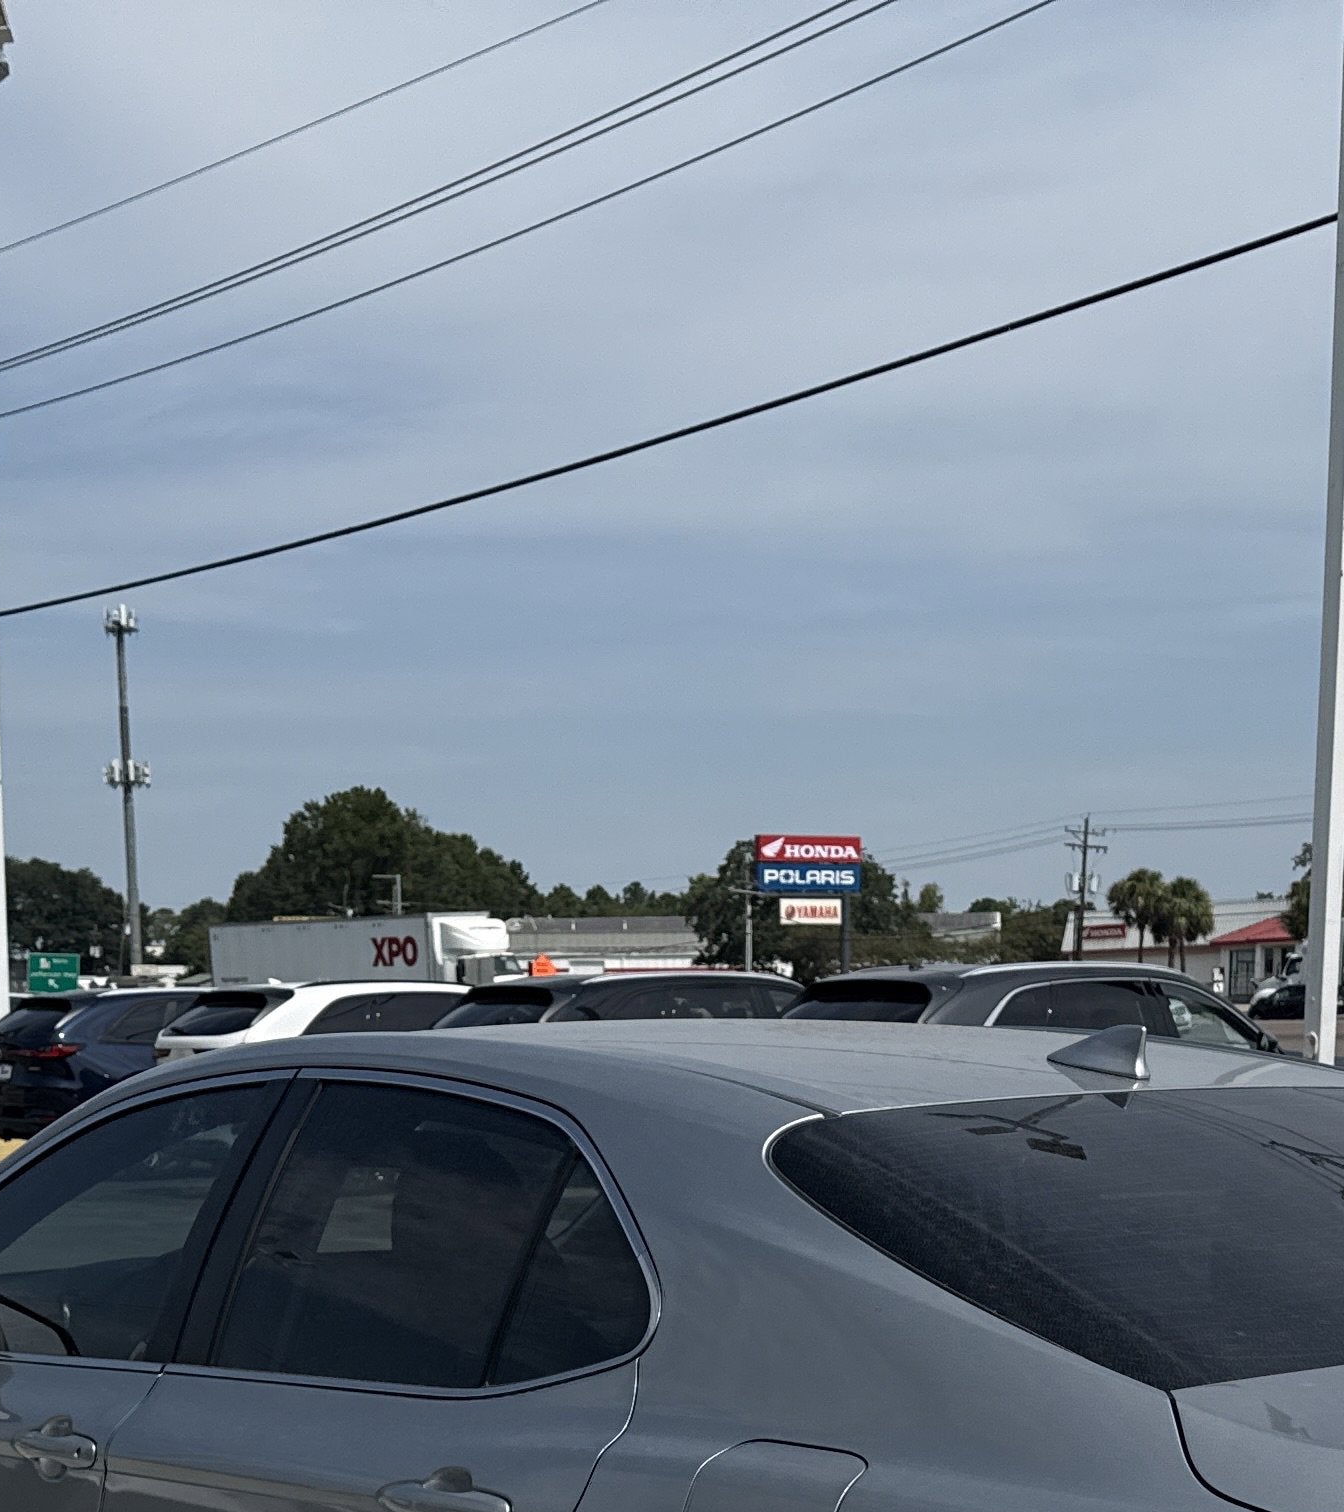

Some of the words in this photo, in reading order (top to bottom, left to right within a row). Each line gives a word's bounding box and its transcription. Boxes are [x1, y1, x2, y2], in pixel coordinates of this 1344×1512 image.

[783, 844, 859, 859] HONDA
[763, 868, 855, 885] POLARIS
[797, 905, 839, 919] YAMAHA
[370, 935, 419, 967] XPO
